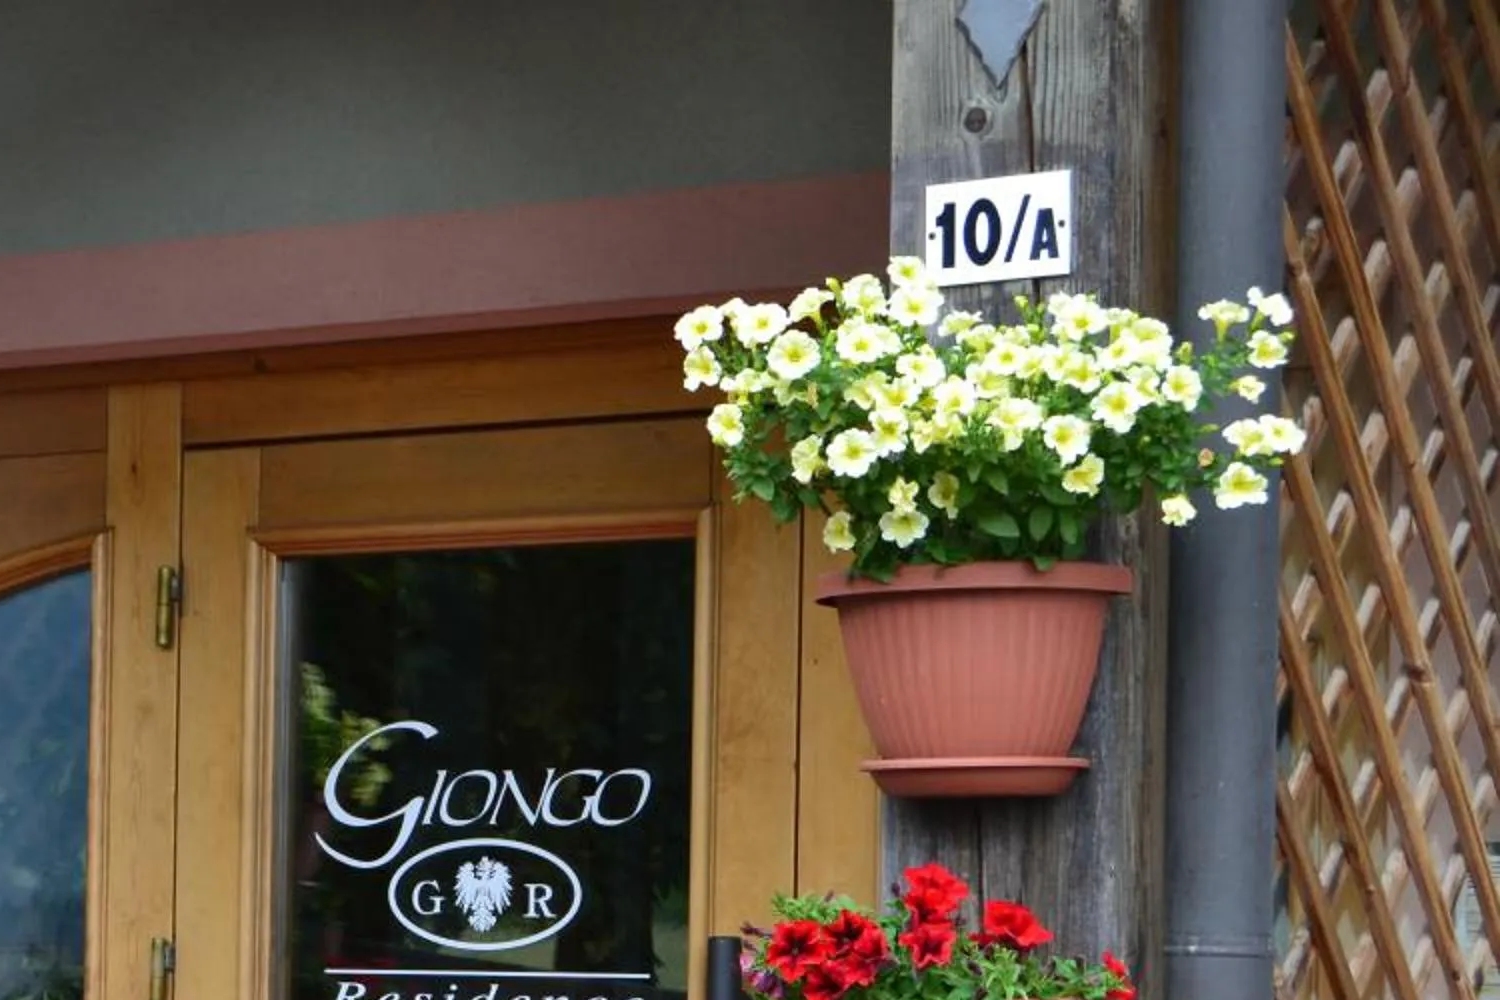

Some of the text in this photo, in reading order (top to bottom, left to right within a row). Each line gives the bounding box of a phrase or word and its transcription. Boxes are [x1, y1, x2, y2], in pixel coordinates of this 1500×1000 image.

[935, 194, 1059, 268] 10/A
[411, 879, 556, 918] G R
